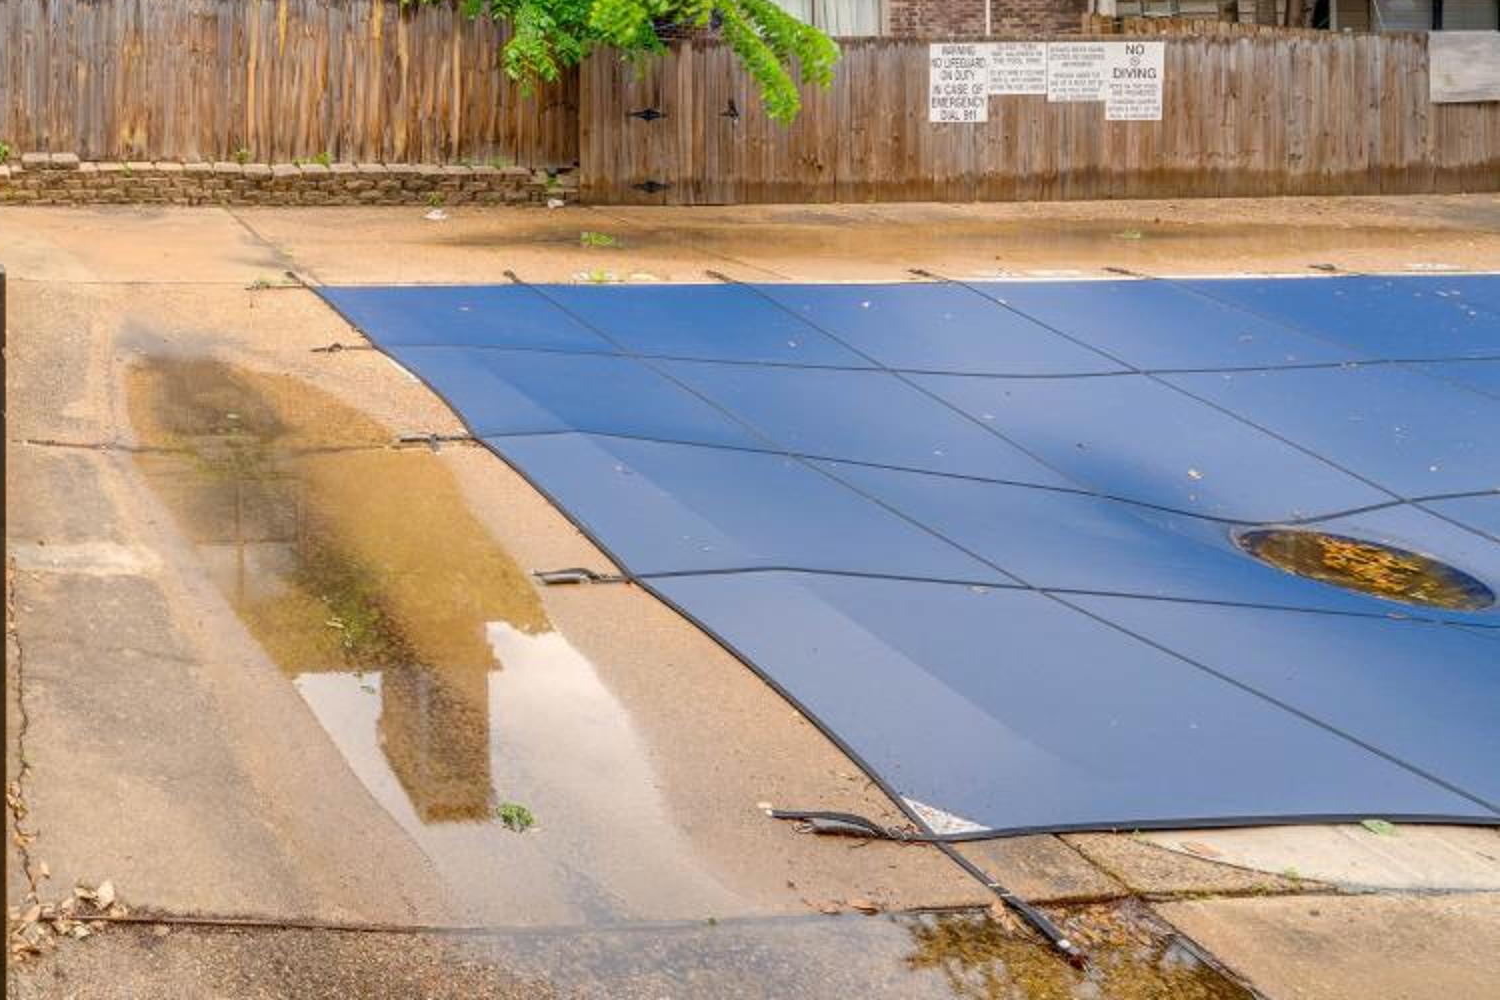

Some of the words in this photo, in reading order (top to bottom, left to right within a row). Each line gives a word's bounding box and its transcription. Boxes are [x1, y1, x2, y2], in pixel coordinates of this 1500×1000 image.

[1125, 43, 1145, 55] NO
[932, 57, 942, 68] NO
[943, 57, 986, 68] LIFEGUARD
[940, 70, 953, 80] ON
[955, 70, 975, 80] DUTY
[1113, 67, 1157, 79] DIVING
[943, 83, 968, 94] CASE
[971, 83, 984, 94] OF
[931, 97, 985, 108] EMERGENCY
[964, 110, 977, 120] 911
